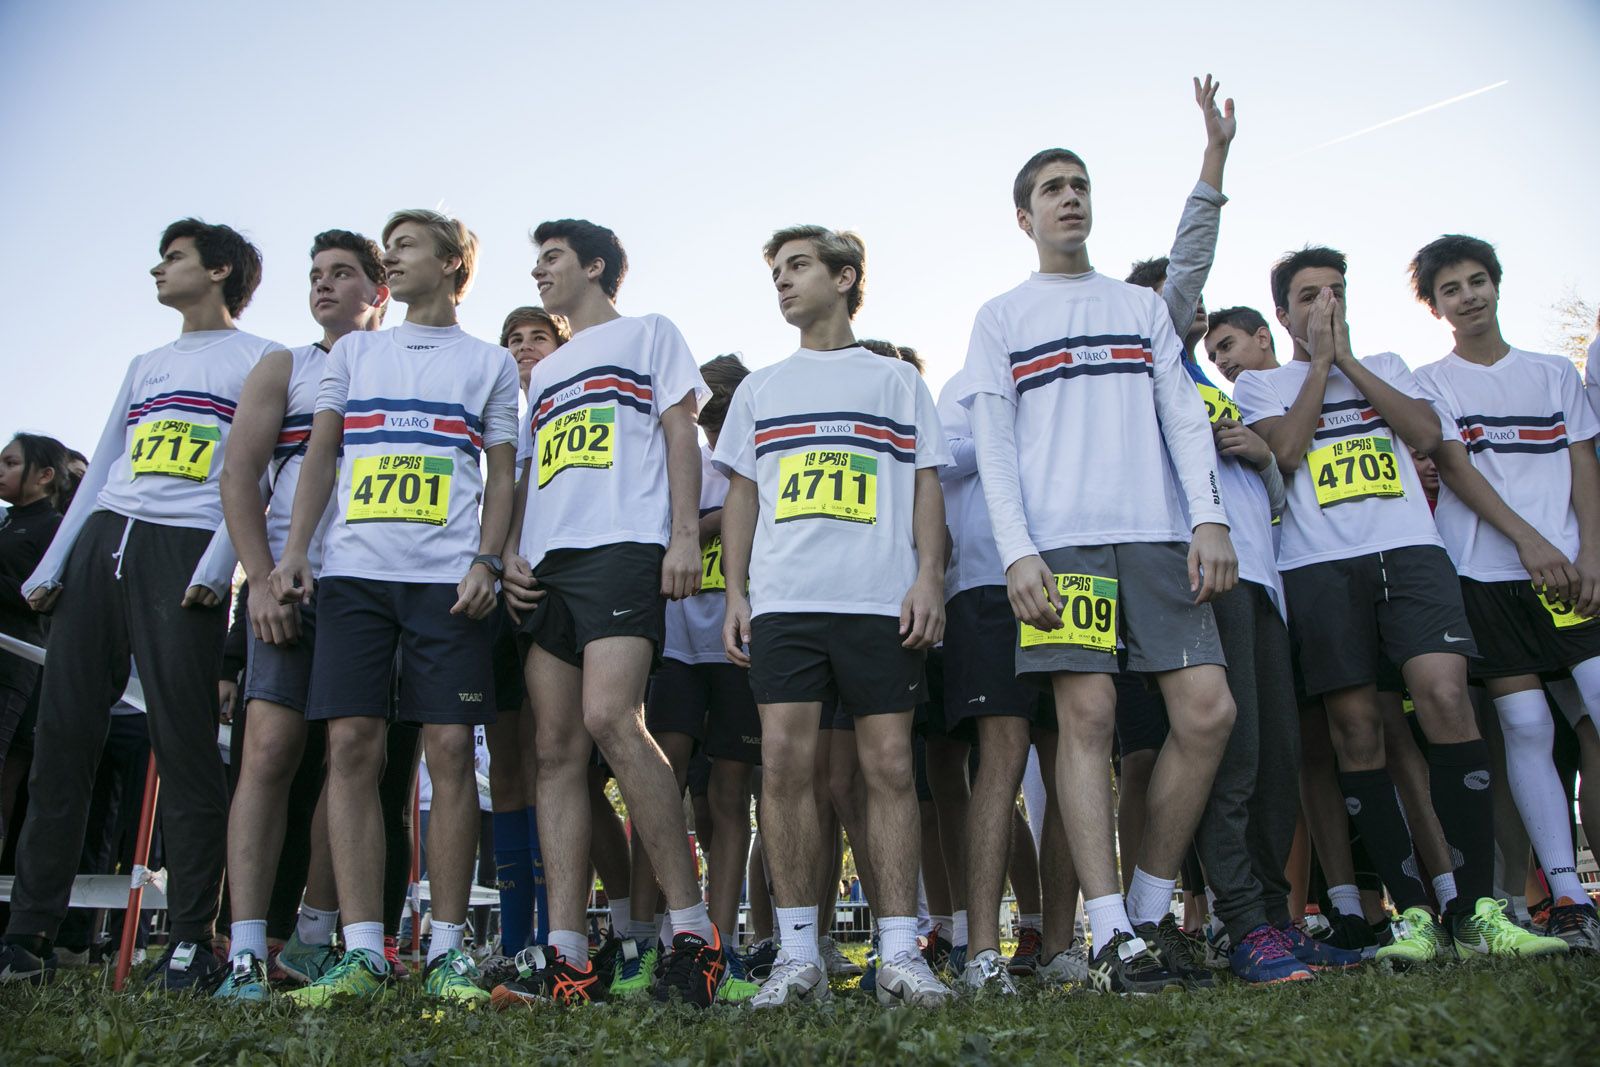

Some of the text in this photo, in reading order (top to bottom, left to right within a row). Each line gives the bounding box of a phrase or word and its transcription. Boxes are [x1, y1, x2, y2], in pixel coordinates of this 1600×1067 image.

[1076, 349, 1108, 361] VIARÓ
[390, 416, 429, 429] VIARÓ
[1328, 411, 1360, 426] VIARÓ
[819, 424, 851, 433] VIARÓ
[131, 434, 210, 464] 4717
[541, 424, 609, 467] 4702
[1332, 443, 1343, 456] 19
[379, 456, 391, 470] 19
[804, 452, 816, 466] 19
[1318, 452, 1396, 488] 4703
[353, 473, 440, 506] 4701
[781, 469, 867, 505] 4711
